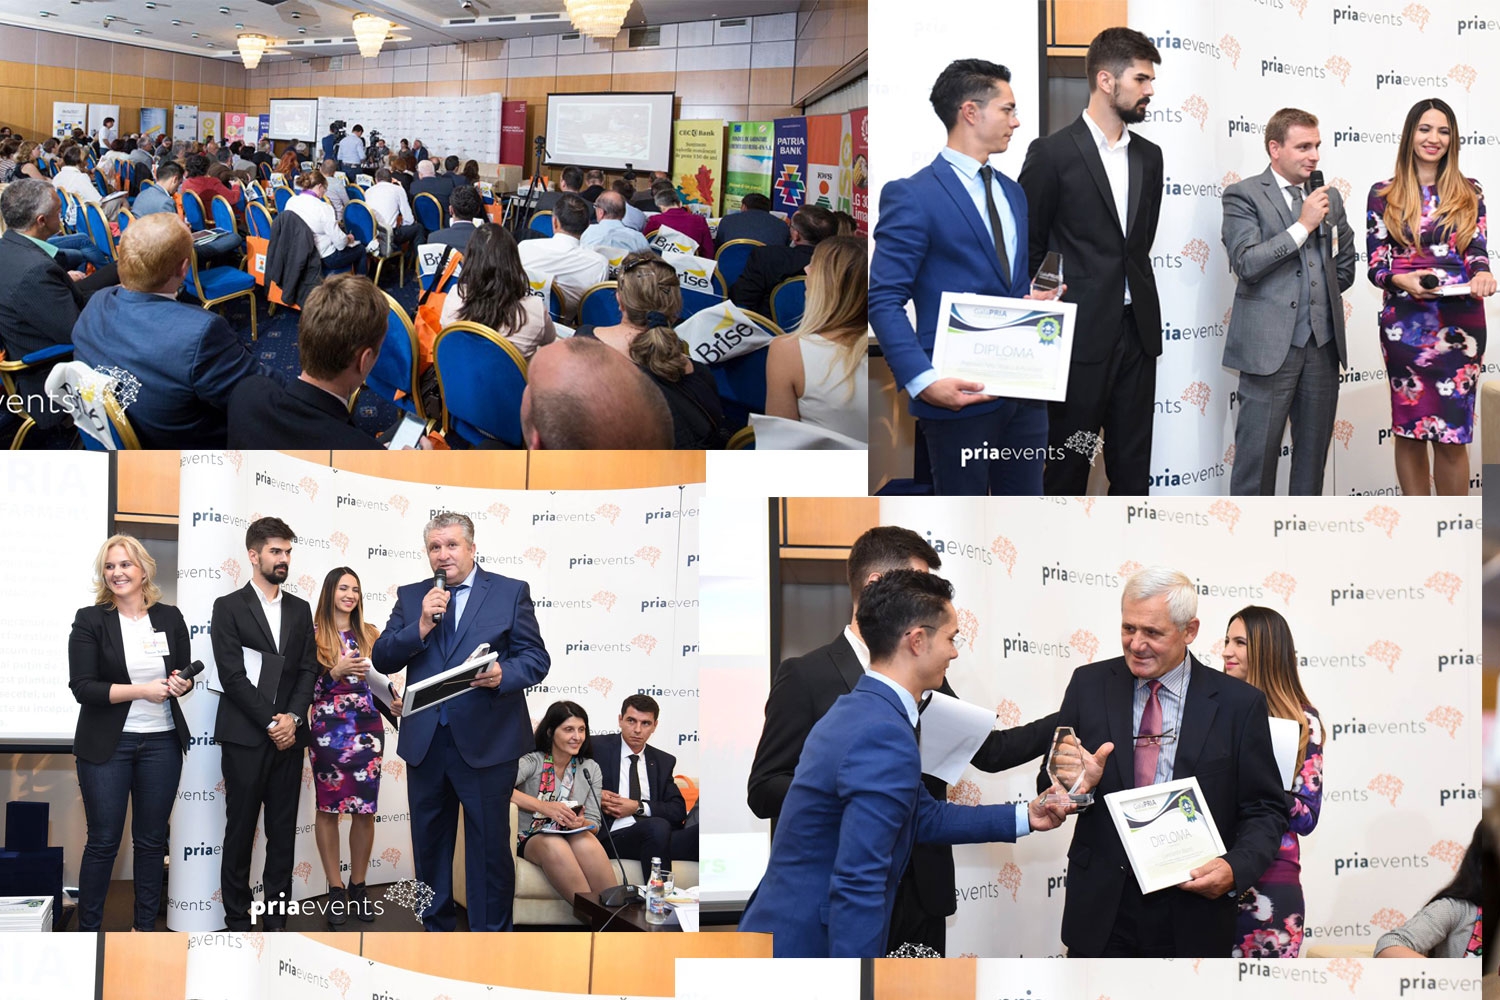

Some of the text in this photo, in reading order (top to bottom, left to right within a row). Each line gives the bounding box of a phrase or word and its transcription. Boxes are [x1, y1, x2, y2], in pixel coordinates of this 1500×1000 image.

[1333, 8, 1402, 26] priaevents
[1262, 57, 1325, 78] priaevents
[1377, 71, 1448, 89] priaevents
[778, 137, 804, 146] PATRIA
[780, 147, 802, 155] BANK
[695, 321, 753, 363] Brise
[973, 343, 1034, 359] DIPLOMA
[256, 470, 299, 494] priaevents
[337, 493, 388, 512] priaevents
[533, 510, 596, 525] priaevents
[1128, 502, 1208, 526] priaevents
[1274, 514, 1364, 537] priaevents
[368, 545, 422, 560] priaevents
[570, 554, 635, 569] priaevents
[1042, 562, 1119, 588] priaevents
[1331, 584, 1424, 606] priaevents
[566, 641, 631, 655] priaevents
[1004, 633, 1070, 658] priaevents
[1332, 718, 1426, 740] priaevents
[1133, 800, 1157, 811] GalaPRIA
[1150, 828, 1192, 848] DIPLOMA
[1335, 852, 1428, 875] priaevents
[279, 958, 328, 988] priaevents
[1238, 959, 1328, 984] priaevents
